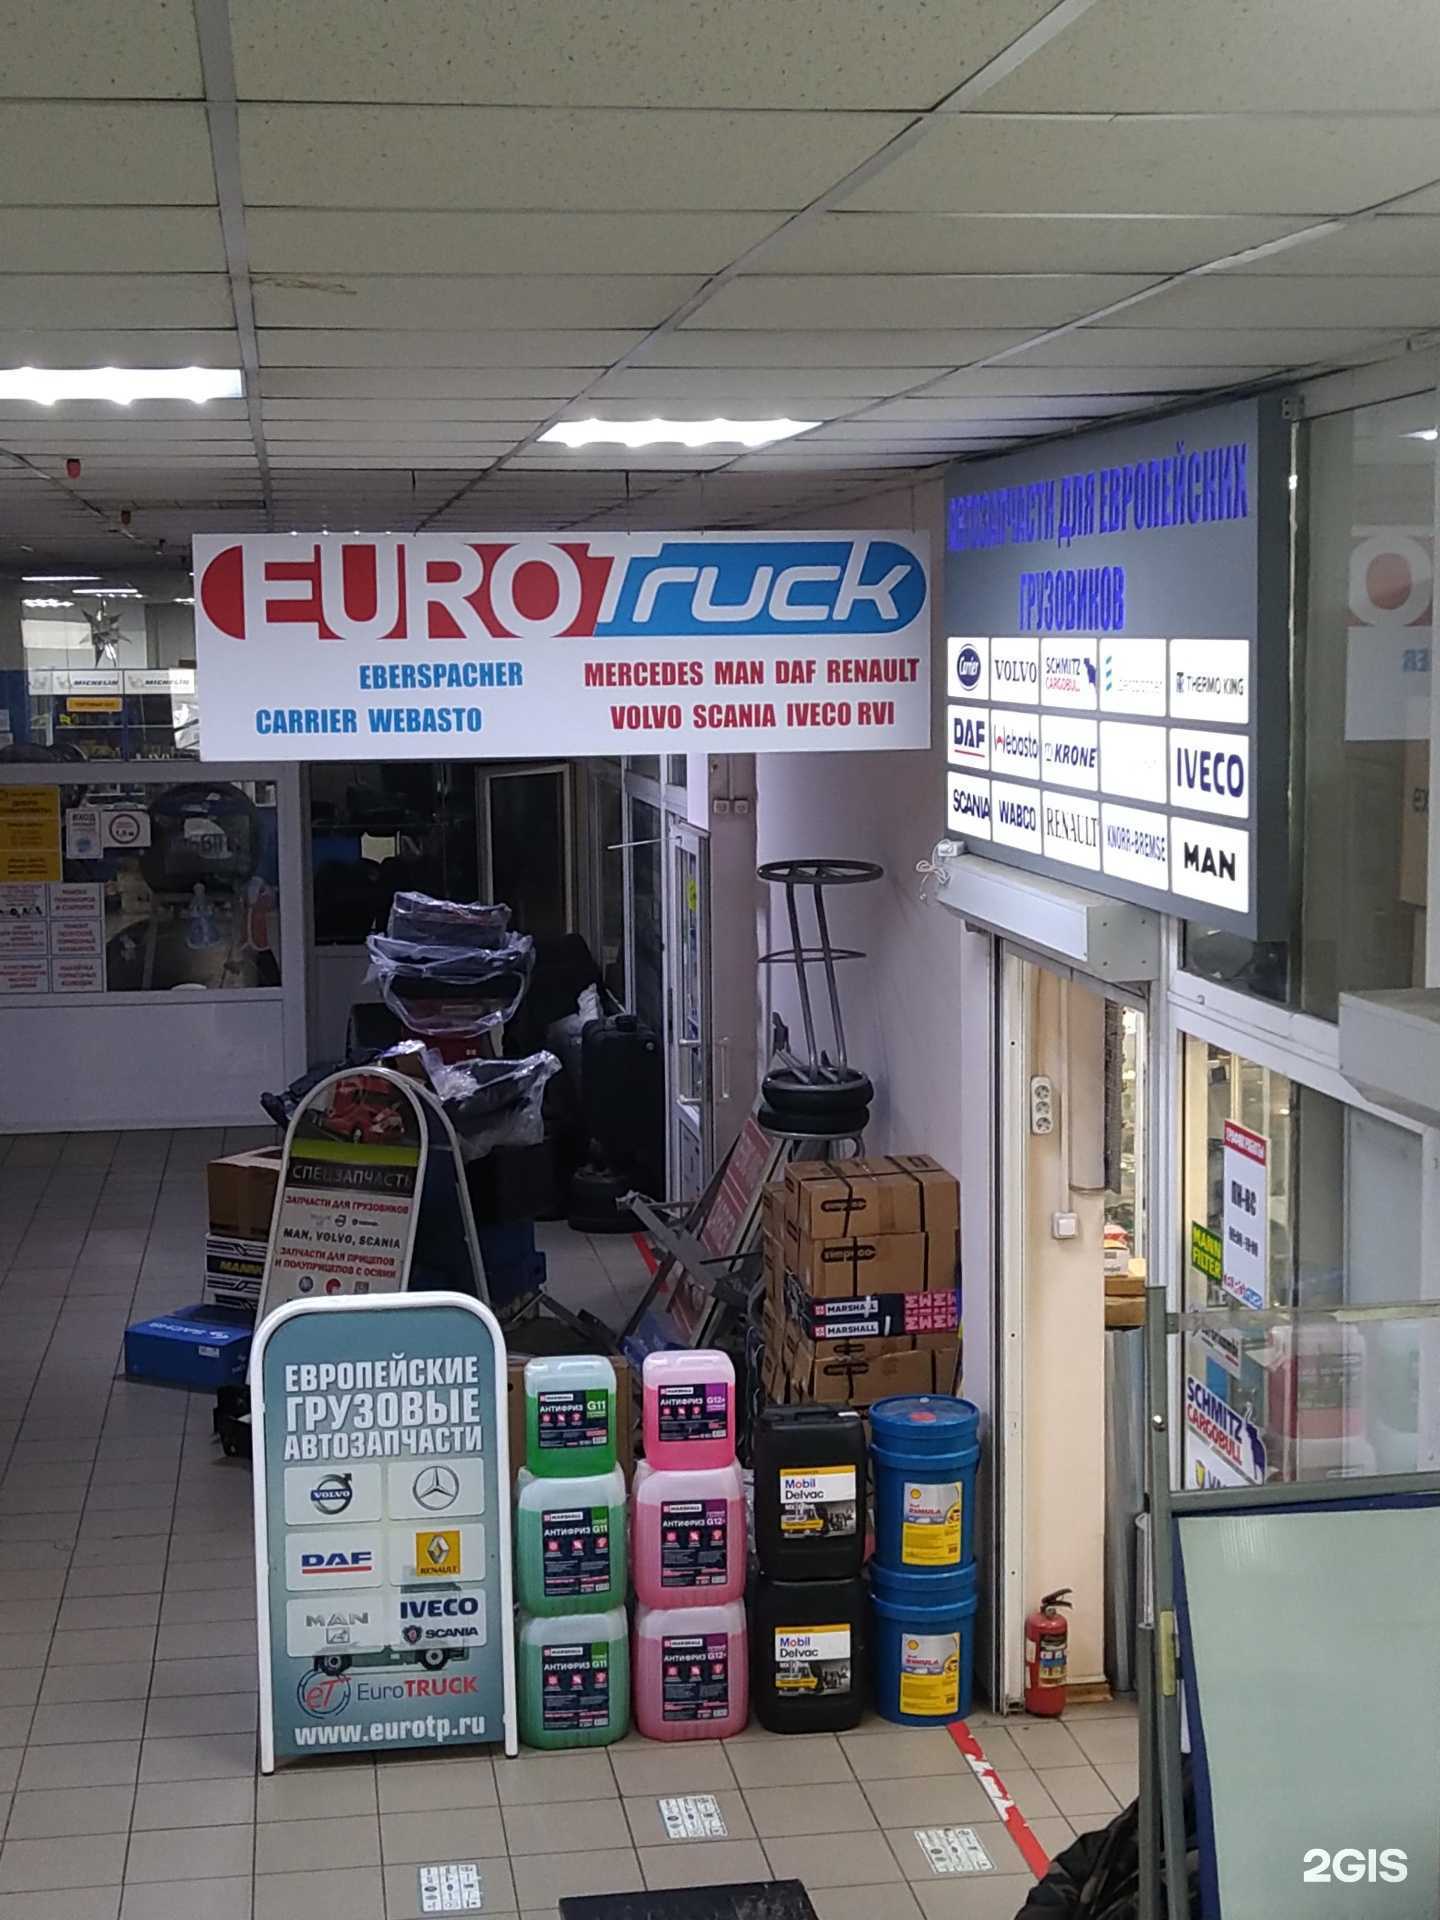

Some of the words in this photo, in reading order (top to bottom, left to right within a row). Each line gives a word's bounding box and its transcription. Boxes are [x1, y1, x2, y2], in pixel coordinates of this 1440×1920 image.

[1058, 472, 1094, 548] ДЛЯ
[1100, 441, 1248, 534] ЕВРОПЕЙСКИХ
[1019, 566, 1125, 631] ГРУЗОВИКОВ
[360, 661, 523, 690] EBERSPACHER
[584, 661, 703, 687] MERCEDES
[714, 660, 764, 686] MAN
[775, 660, 817, 685] DAF
[827, 658, 919, 683] RENAULT
[995, 659, 1037, 683] VOLVO
[1046, 657, 1080, 675] SCHMITZ
[1224, 678, 1243, 695] KING
[256, 709, 358, 735] CARRIER
[368, 707, 482, 733] WEBASTO
[610, 705, 682, 730] VOLVO
[693, 703, 776, 728] SCANIA
[787, 702, 850, 727] IVECO
[857, 701, 895, 725] RVI
[954, 717, 985, 749] DAF
[1054, 743, 1096, 768] KRONE
[1177, 747, 1244, 798] IVECO
[953, 788, 991, 819] SCANIA
[999, 799, 1037, 832] WABCO
[1046, 807, 1098, 848] RENAULT
[1107, 825, 1165, 862] KNORR-BREMSE
[1184, 842, 1236, 881] MAN
[286, 1196, 331, 1208] ЗАПЧАСТИ
[332, 1201, 351, 1210] ДЛЯ
[352, 1202, 409, 1214] ГРУЗОВИКОВ
[280, 1247, 326, 1260] ЗАПЧАСТИ
[326, 1251, 345, 1261] ДЛЯ
[359, 1235, 400, 1249] SCANIA
[827, 1301, 876, 1313] MARSHAL
[827, 1324, 876, 1335] MARSHALL
[284, 1352, 479, 1393] ЕВРОПЕЙСКИЕ
[286, 1388, 481, 1432] ГРУЗОВЫЕ
[540, 1404, 583, 1412] АНТИФРИЗ
[587, 1400, 606, 1410] G11
[1187, 1376, 1242, 1444] SCHMITZ
[283, 1426, 482, 1461] АВТОЗАПЧАСТИ
[1187, 1403, 1242, 1466] CARGOBULL
[313, 1490, 350, 1499] VOLVO
[785, 1478, 816, 1488] Mobil
[785, 1490, 824, 1500] Delvac
[544, 1526, 590, 1536] АНТИФРИЗ
[592, 1525, 607, 1533] G11
[302, 1552, 372, 1567] DAF
[420, 1566, 459, 1575] RENAULT
[306, 1612, 368, 1627] MAN
[400, 1597, 478, 1619] IVECO
[425, 1627, 478, 1639] SCANIA
[780, 1637, 810, 1647] Mobil
[544, 1662, 590, 1670] АНТИФРИЗ
[592, 1660, 607, 1668] G11
[664, 1654, 706, 1662] АНТИФРИЗ
[780, 1648, 819, 1658] Delvac
[357, 1675, 479, 1700] EuroTRUCK
[294, 1715, 486, 1745] www.eurotp.ru
